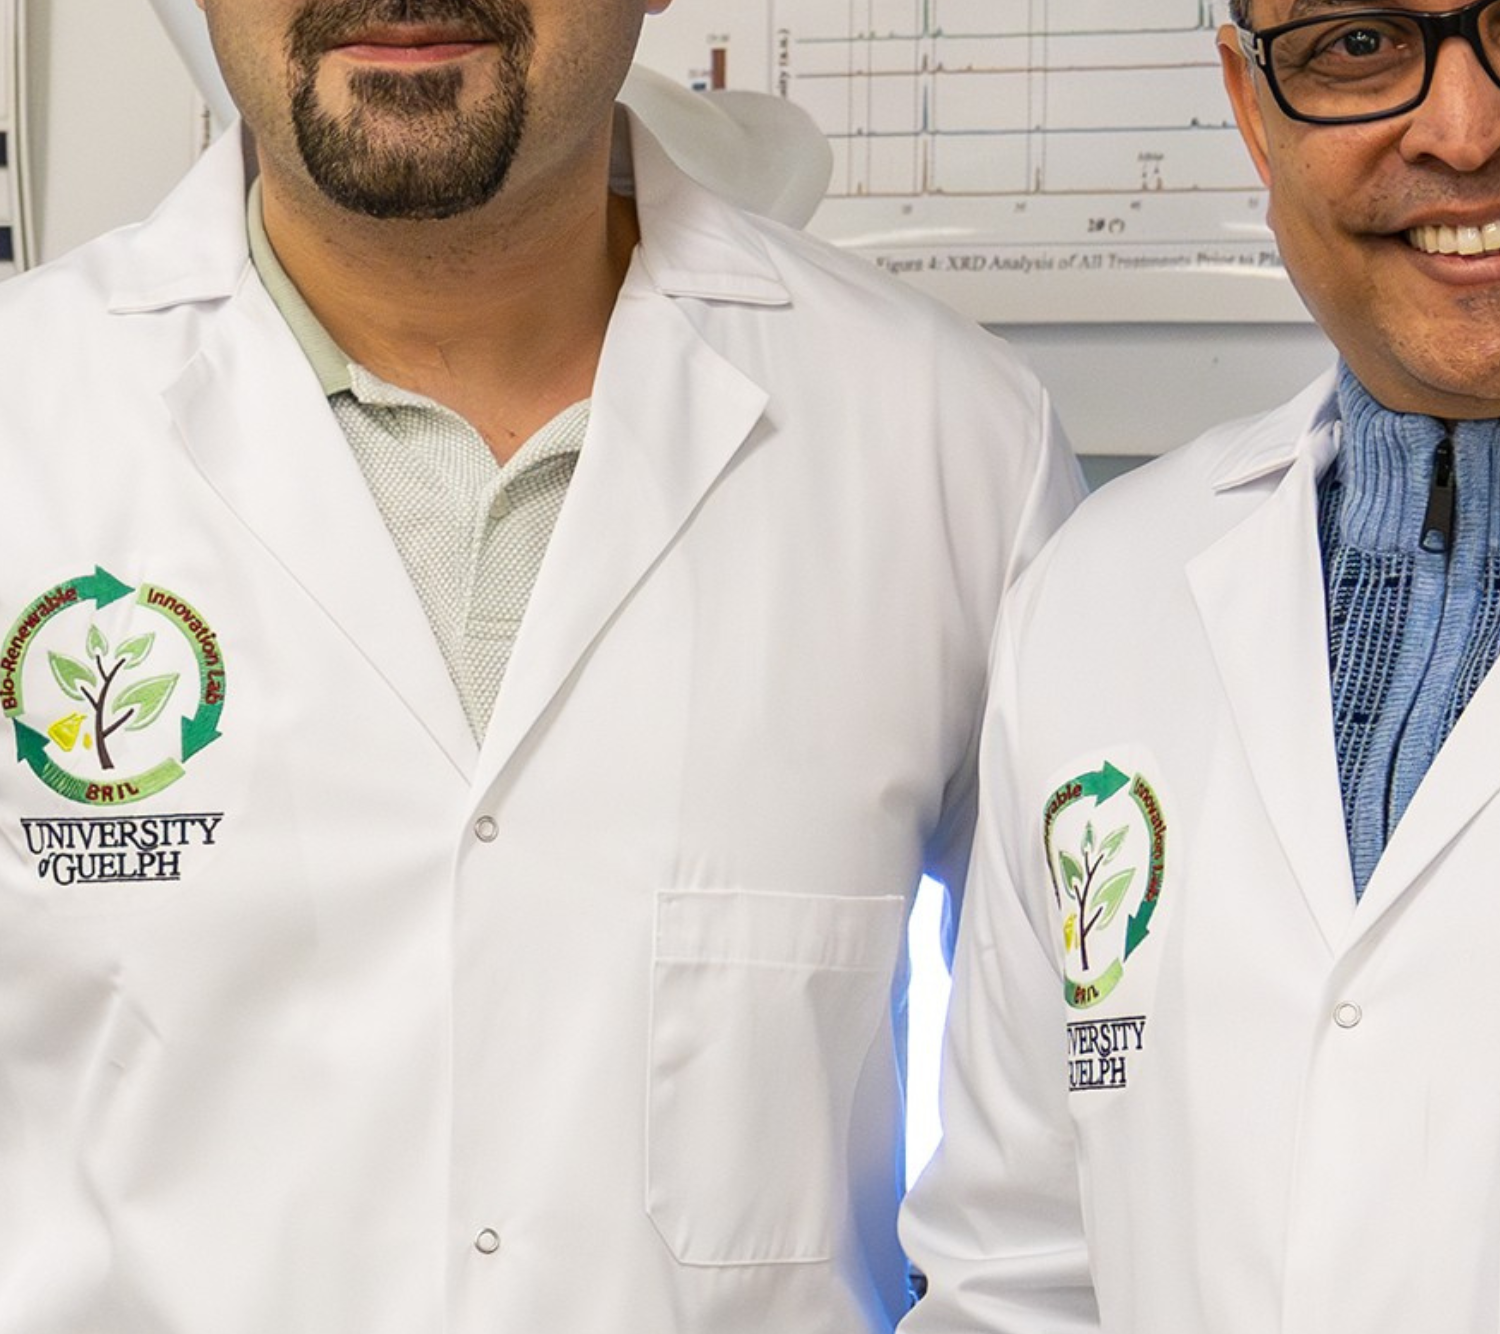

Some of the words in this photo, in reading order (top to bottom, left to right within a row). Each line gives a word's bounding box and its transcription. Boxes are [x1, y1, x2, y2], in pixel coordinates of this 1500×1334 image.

[147, 588, 221, 668] Innovation
[205, 669, 226, 705] Lab
[85, 783, 139, 802] BRIL
[21, 818, 221, 855] UNIVERSITY
[52, 851, 181, 885] GUELPH
[1067, 1021, 1145, 1057] VERSITY
[1069, 1057, 1126, 1087] UELPH
